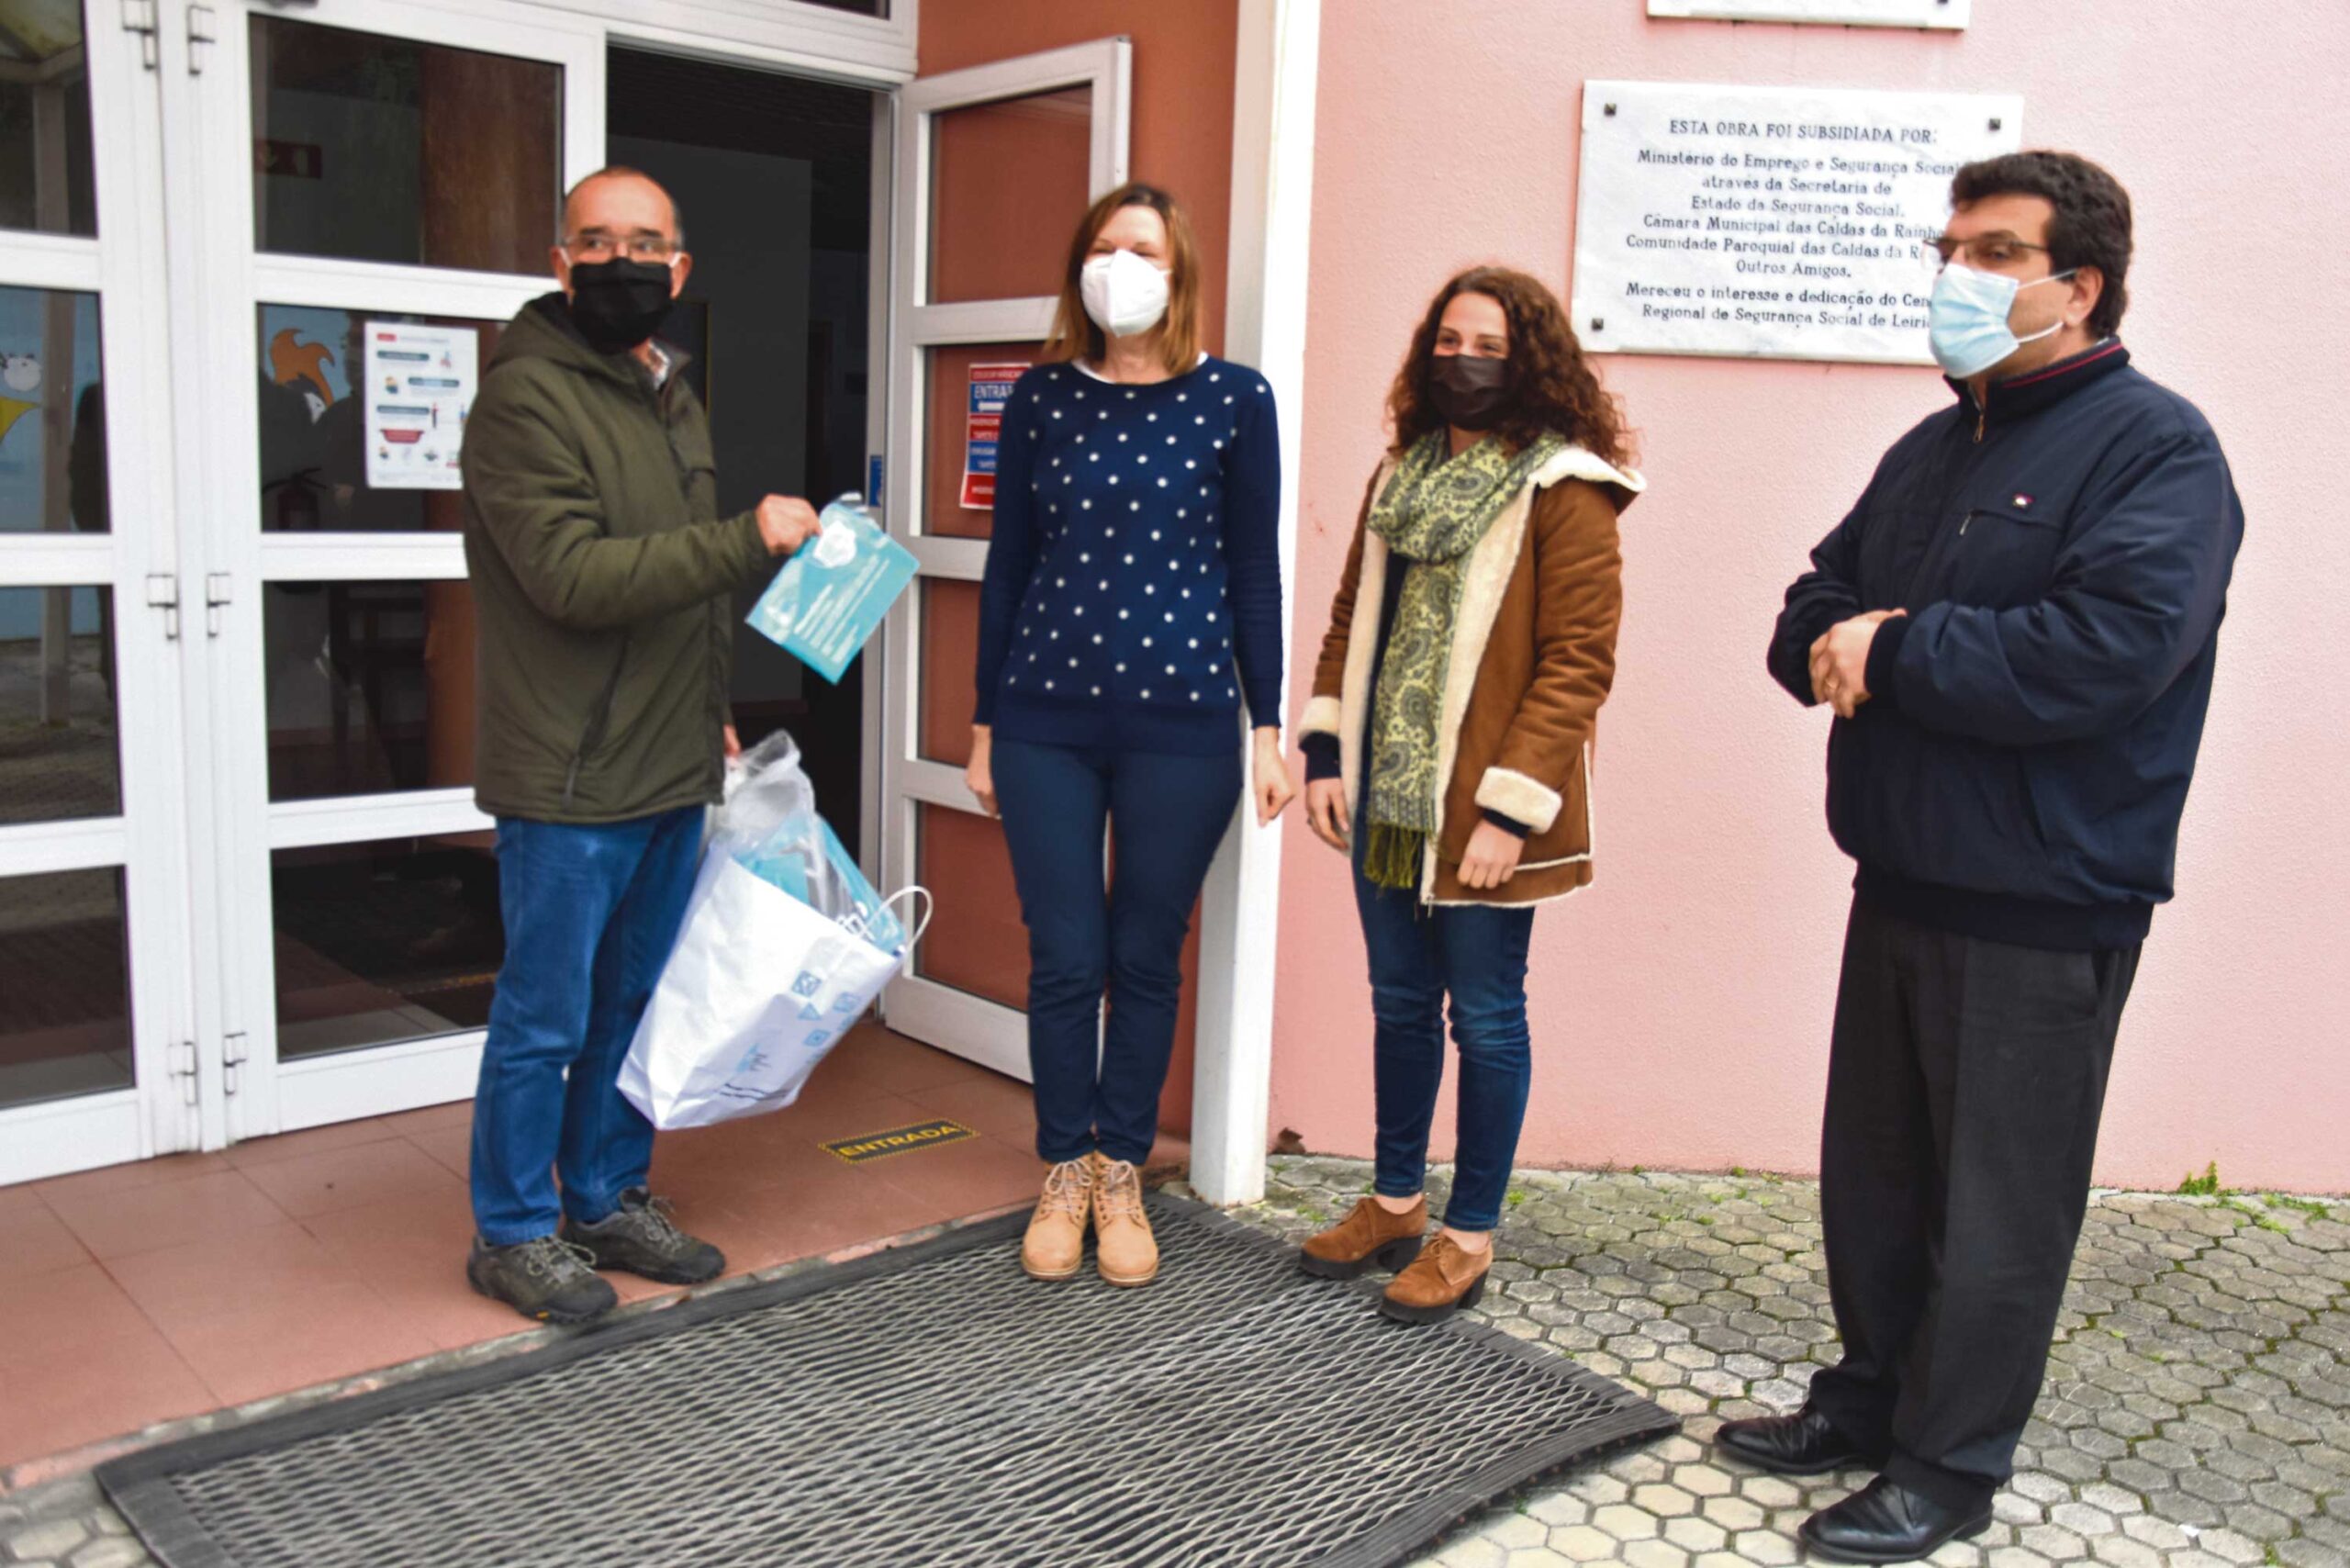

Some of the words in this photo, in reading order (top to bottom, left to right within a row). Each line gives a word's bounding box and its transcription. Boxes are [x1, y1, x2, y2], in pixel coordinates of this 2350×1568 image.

[1670, 119, 1708, 134] ESTA
[1717, 121, 1759, 137] OBRA
[1766, 123, 1791, 138] FOI
[1797, 125, 1893, 142] SUBSIDIADA
[1638, 149, 1714, 165] Ministério
[1721, 153, 1738, 167] do
[1744, 153, 1809, 172] Emprego
[1816, 160, 1824, 170] e
[1830, 157, 1908, 178] Segurança
[1702, 174, 1759, 190] através
[1765, 178, 1782, 191] da
[1788, 178, 1867, 195] Secretaria
[1874, 182, 1891, 195] de
[1692, 196, 1740, 210] Estado
[1748, 198, 1764, 211] da
[1772, 199, 1849, 219] Segurança
[1856, 202, 1905, 217] Social.
[1643, 214, 1699, 230] Câmara
[1707, 217, 1780, 235] Municipal
[1786, 220, 1811, 234] das
[1817, 221, 1864, 236] Caldas
[1871, 224, 1887, 238] da
[1627, 234, 1717, 251] Comunidade
[1723, 238, 1794, 255] Paroquial
[1801, 242, 1826, 255] das
[1832, 242, 1879, 257] Caldas
[1885, 245, 1902, 258] da
[1736, 259, 1786, 274] Outros
[1792, 263, 1852, 278] Amigos.
[1626, 282, 1691, 298] Mereceu
[1697, 287, 1705, 298] o
[1711, 285, 1779, 301] interesse
[1785, 291, 1794, 301] e
[1798, 290, 1873, 310] dedicação
[1879, 293, 1897, 305] do
[1642, 304, 1706, 320] Regional
[1712, 308, 1729, 320] de
[1735, 308, 1812, 329] Segurança
[1818, 311, 1863, 326] Social
[1868, 314, 1886, 327] de
[838, 1126, 961, 1157] ENTRADA
